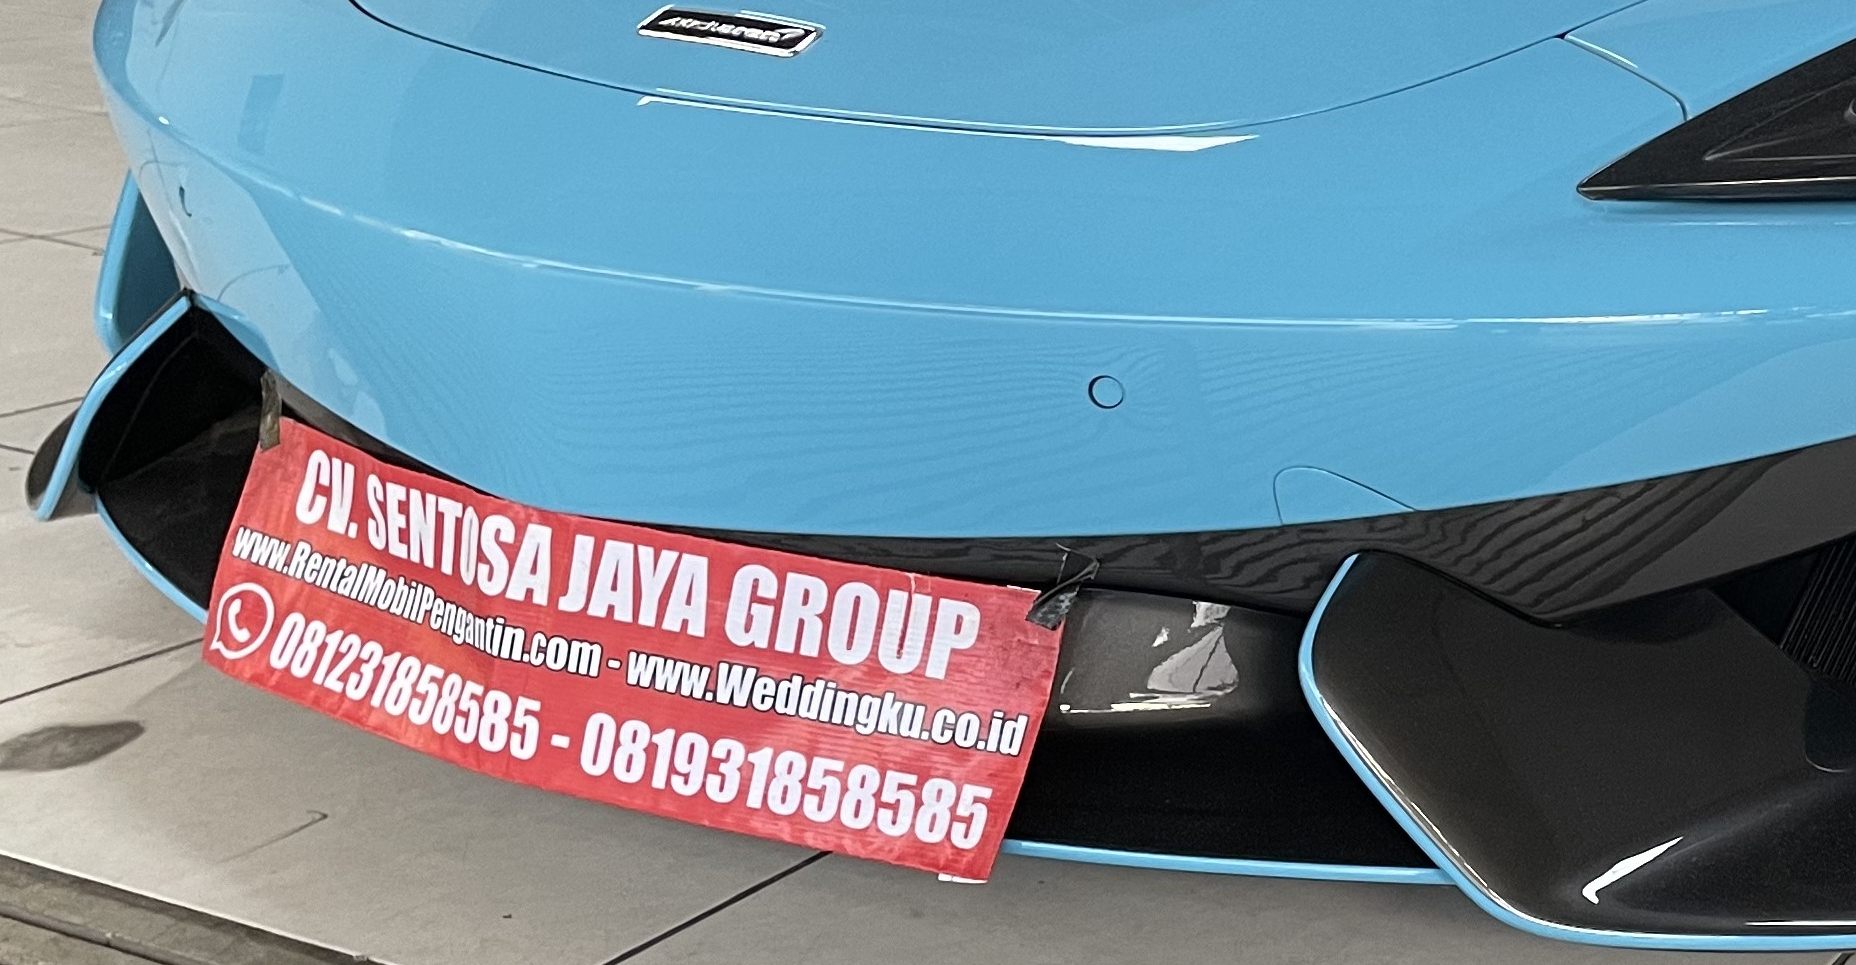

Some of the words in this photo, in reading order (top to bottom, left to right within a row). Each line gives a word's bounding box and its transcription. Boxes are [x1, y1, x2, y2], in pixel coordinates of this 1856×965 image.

[231, 526, 603, 678] www.RentalMobilPengantin.com
[626, 651, 1029, 756] www.Weddingku.co.id
[295, 449, 358, 539] CV.
[366, 473, 552, 607] SENTOSA
[557, 534, 709, 638] JAYA
[724, 564, 982, 680] GROUP
[268, 611, 542, 761] 081231858585
[580, 712, 993, 850] 081931858585
